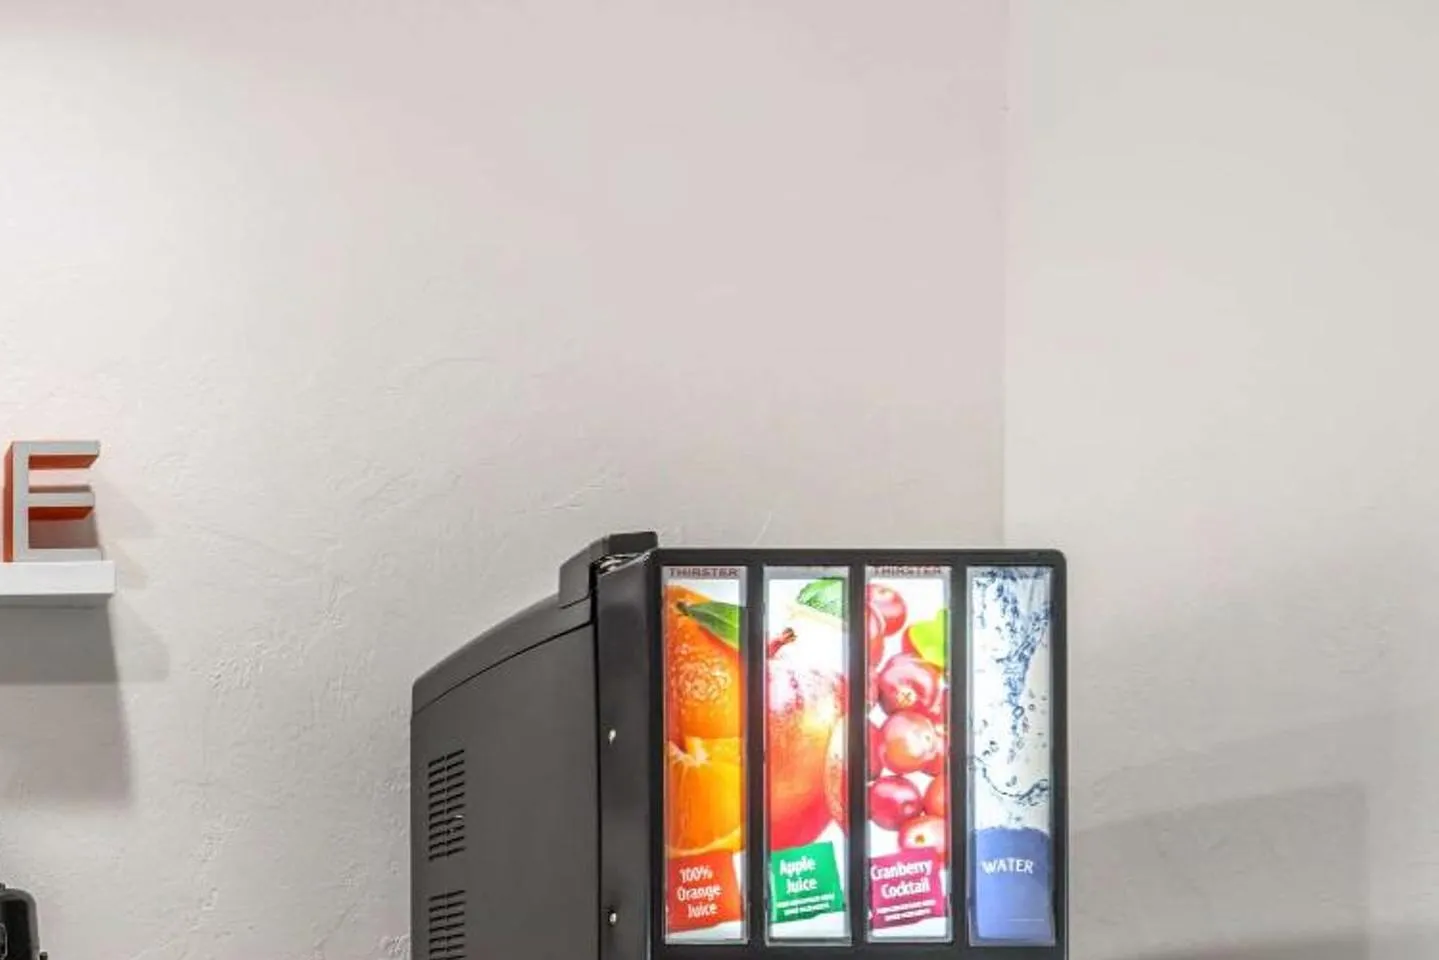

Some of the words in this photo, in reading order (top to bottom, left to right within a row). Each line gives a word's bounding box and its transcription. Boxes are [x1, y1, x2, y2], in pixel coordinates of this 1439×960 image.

[779, 854, 817, 877] Apple
[870, 860, 933, 881] Cranberry
[981, 857, 1034, 874] WATER
[676, 885, 723, 902] Orange
[786, 877, 818, 894] Juice
[881, 877, 931, 899] Cocktail
[687, 903, 718, 918] Juice
